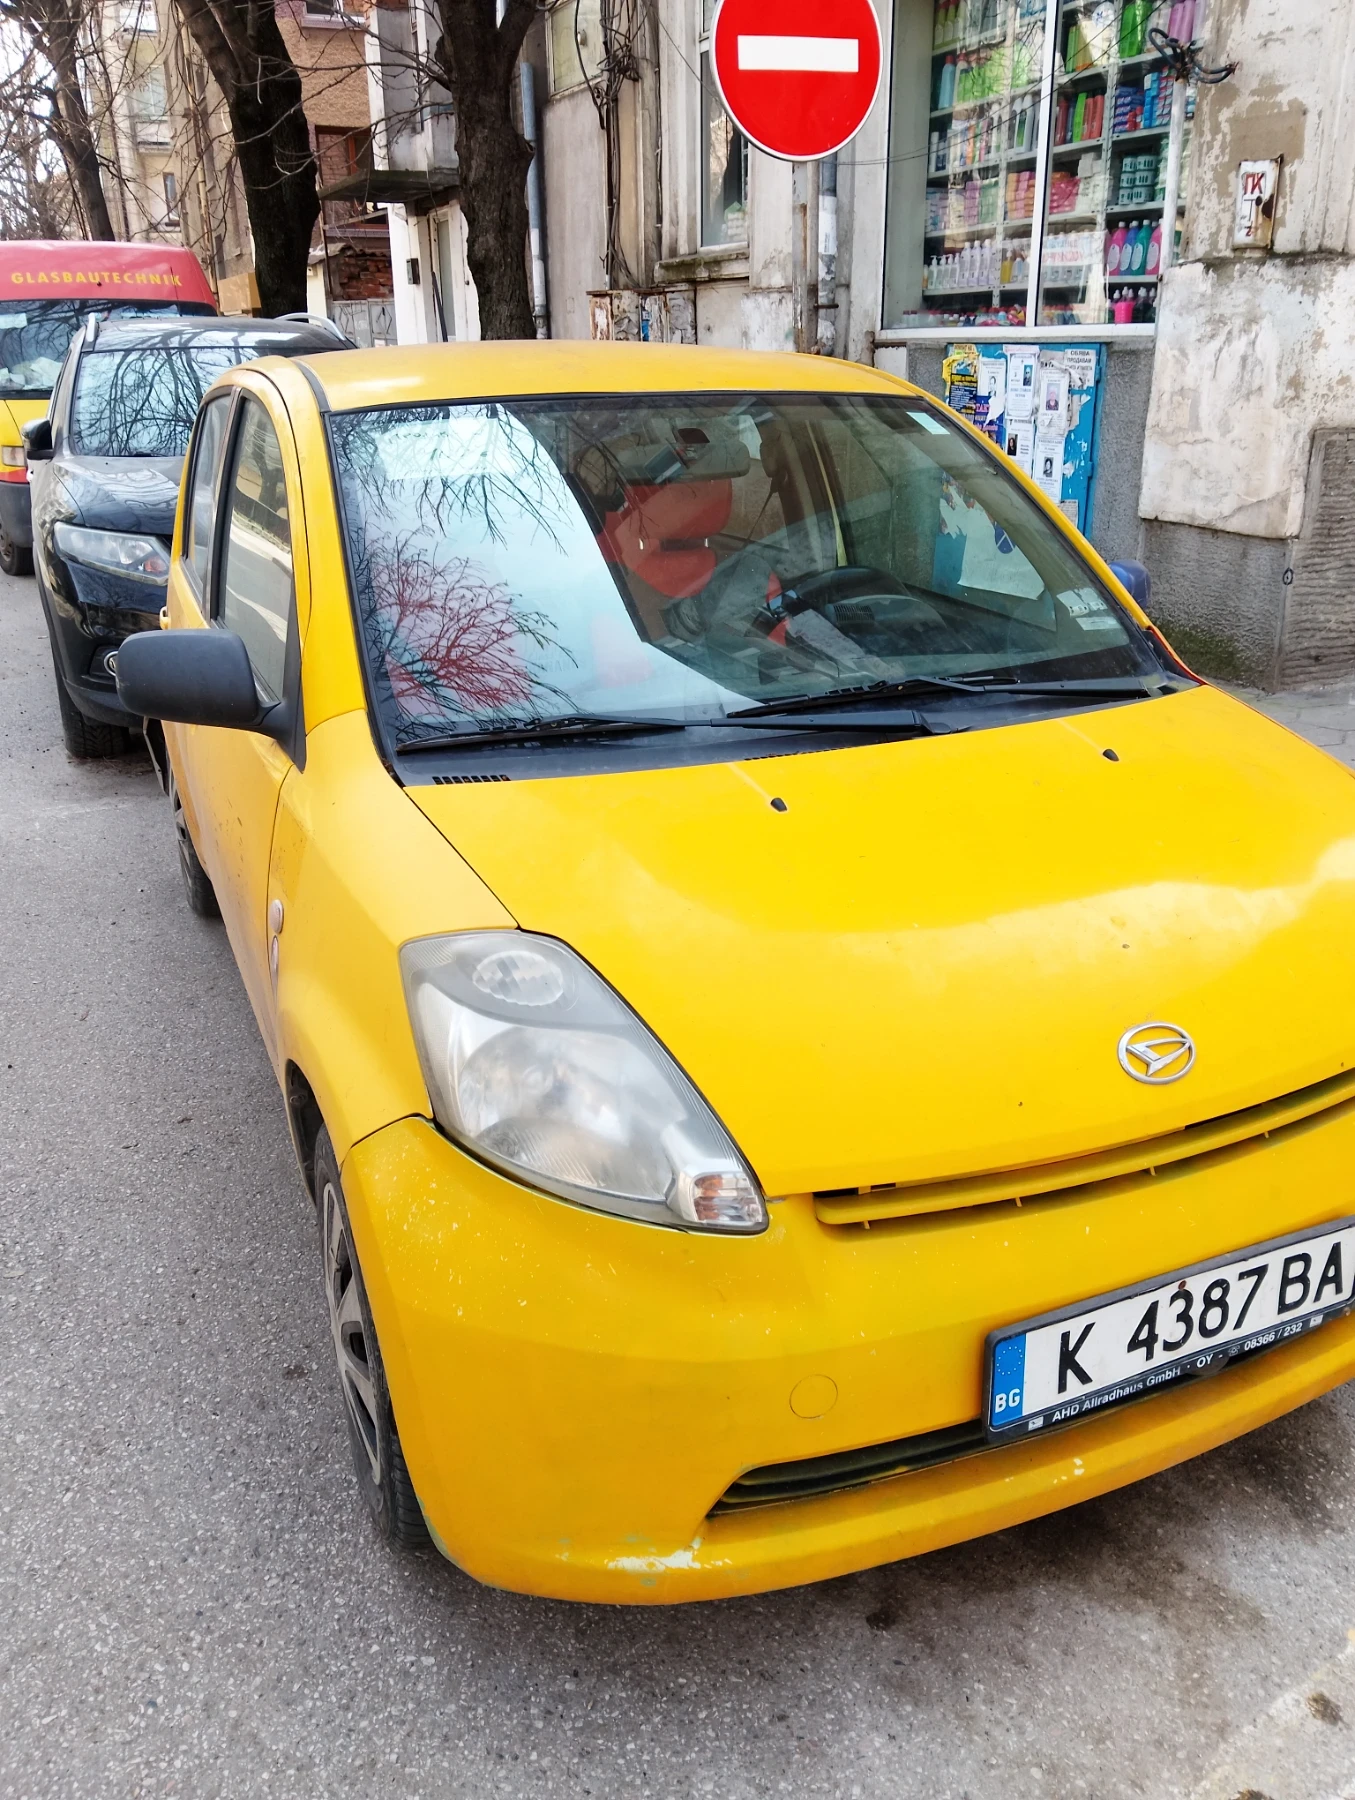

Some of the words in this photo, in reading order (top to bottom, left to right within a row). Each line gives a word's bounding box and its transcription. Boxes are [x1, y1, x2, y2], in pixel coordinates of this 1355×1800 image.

[11, 271, 182, 286] GLASBAUTECHNIK
[1057, 1321, 1095, 1394] K
[1127, 1262, 1269, 1362] 4387
[1277, 1241, 1344, 1315] BA
[994, 1388, 1021, 1413] BG
[1052, 1404, 1080, 1423] AHD
[1082, 1381, 1143, 1411] Allradhaus
[1146, 1366, 1181, 1387] GmbH
[1196, 1353, 1214, 1368] OY
[1244, 1331, 1275, 1351] 08366
[1283, 1322, 1303, 1337] 232
